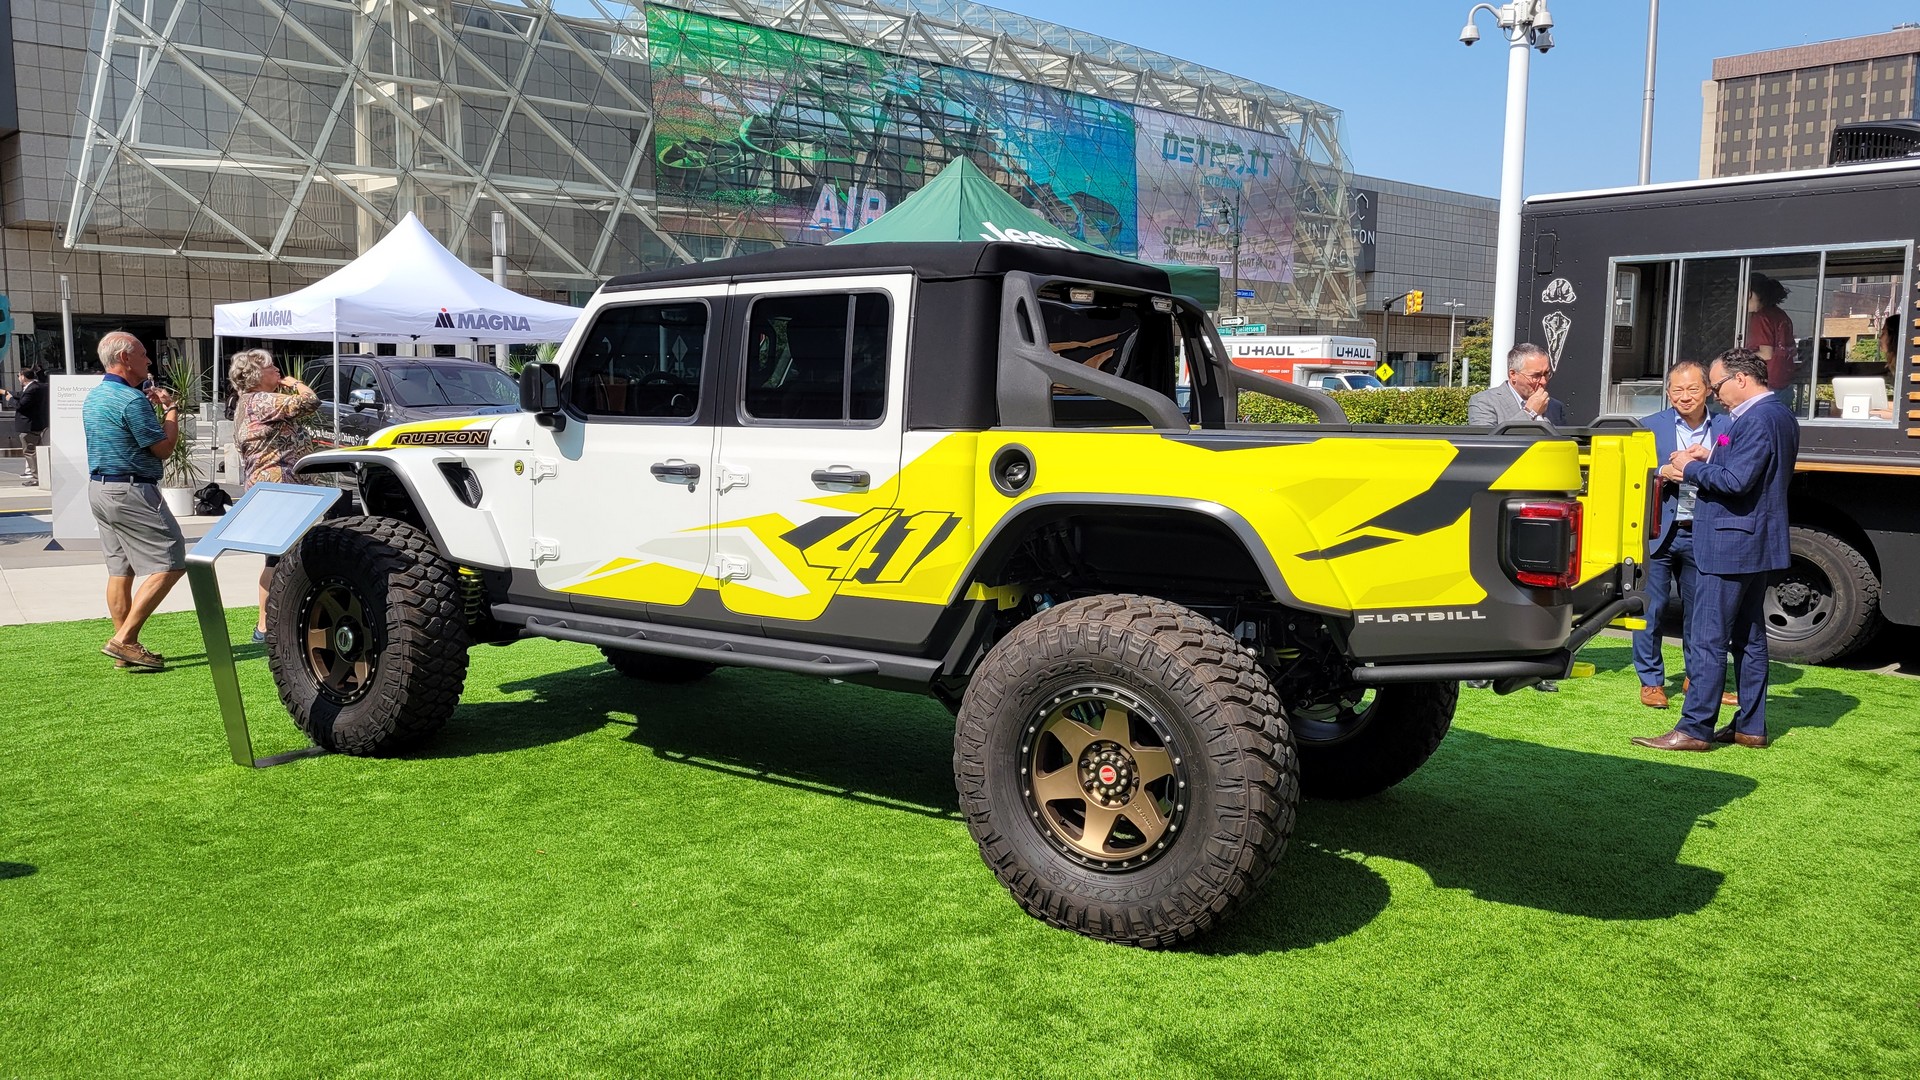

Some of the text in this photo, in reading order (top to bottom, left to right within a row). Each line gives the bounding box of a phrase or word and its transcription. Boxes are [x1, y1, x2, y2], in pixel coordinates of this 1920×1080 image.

[1162, 132, 1274, 177] DETROIT
[808, 183, 888, 233] AIR
[1163, 225, 1241, 252] SEPTEMBE
[259, 310, 292, 327] MAGNA
[457, 313, 531, 331] MAGNA
[397, 431, 488, 446] RUBICON
[795, 507, 960, 584] 41
[1358, 610, 1487, 624] FLATBILL
